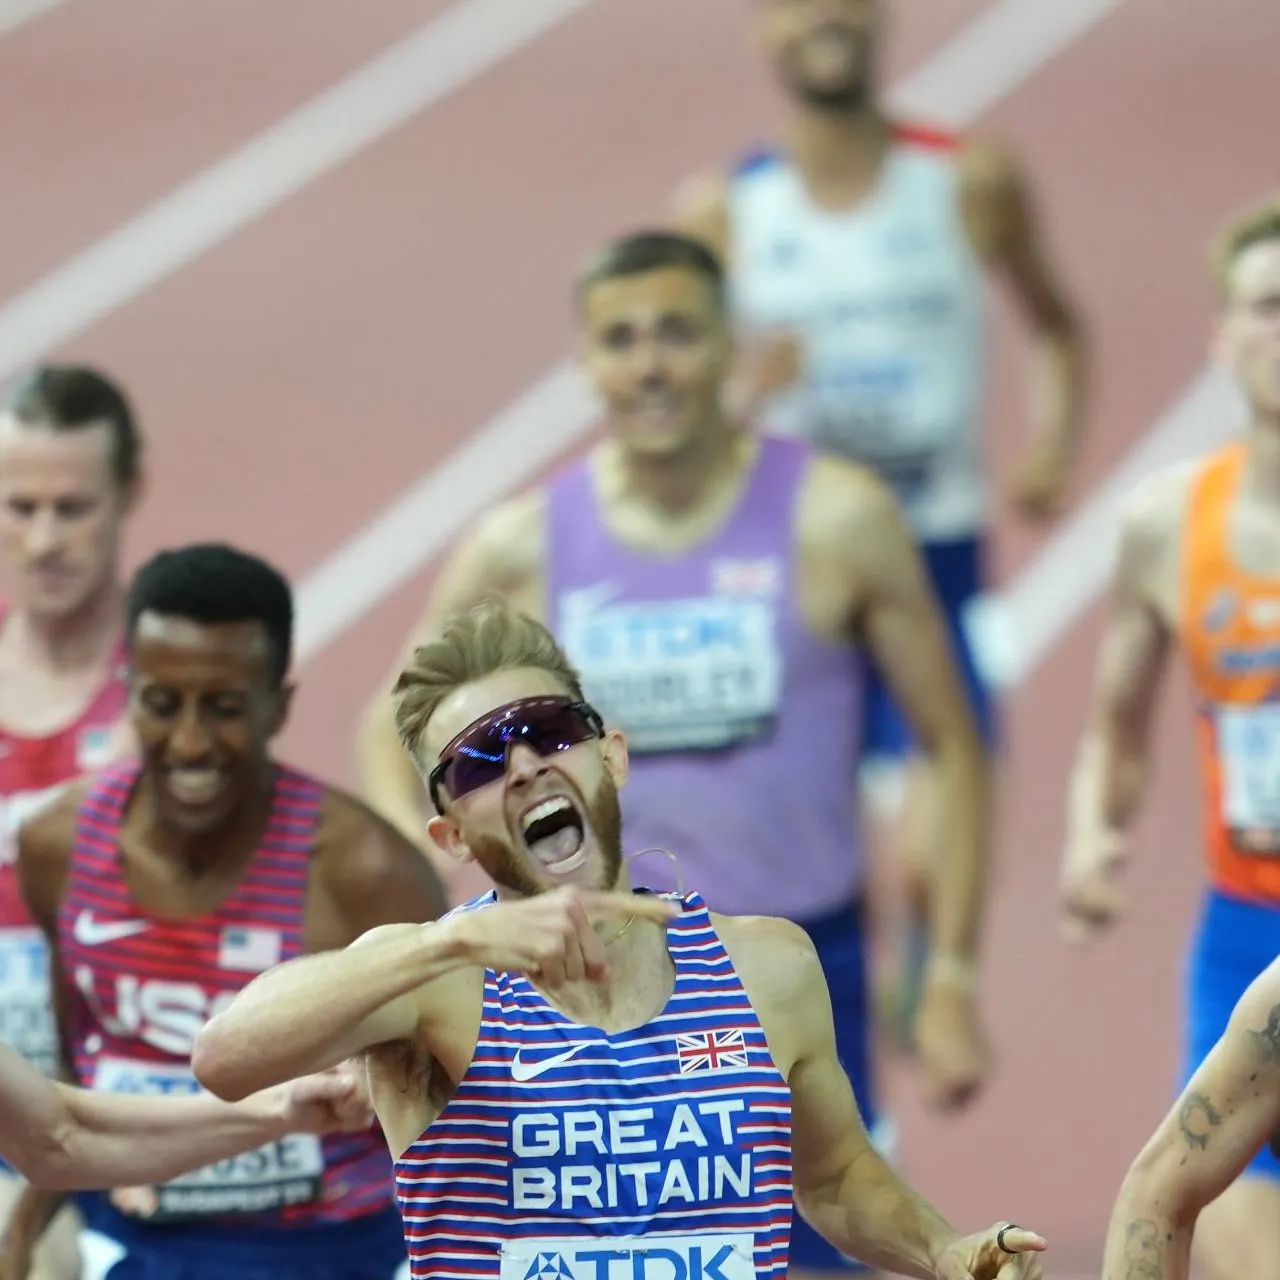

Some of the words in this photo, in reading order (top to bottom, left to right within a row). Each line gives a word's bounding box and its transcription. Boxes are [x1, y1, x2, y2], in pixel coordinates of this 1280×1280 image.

[73, 962, 241, 1056] US
[511, 1099, 746, 1157] GREAT
[511, 1153, 753, 1210] BRITAIN
